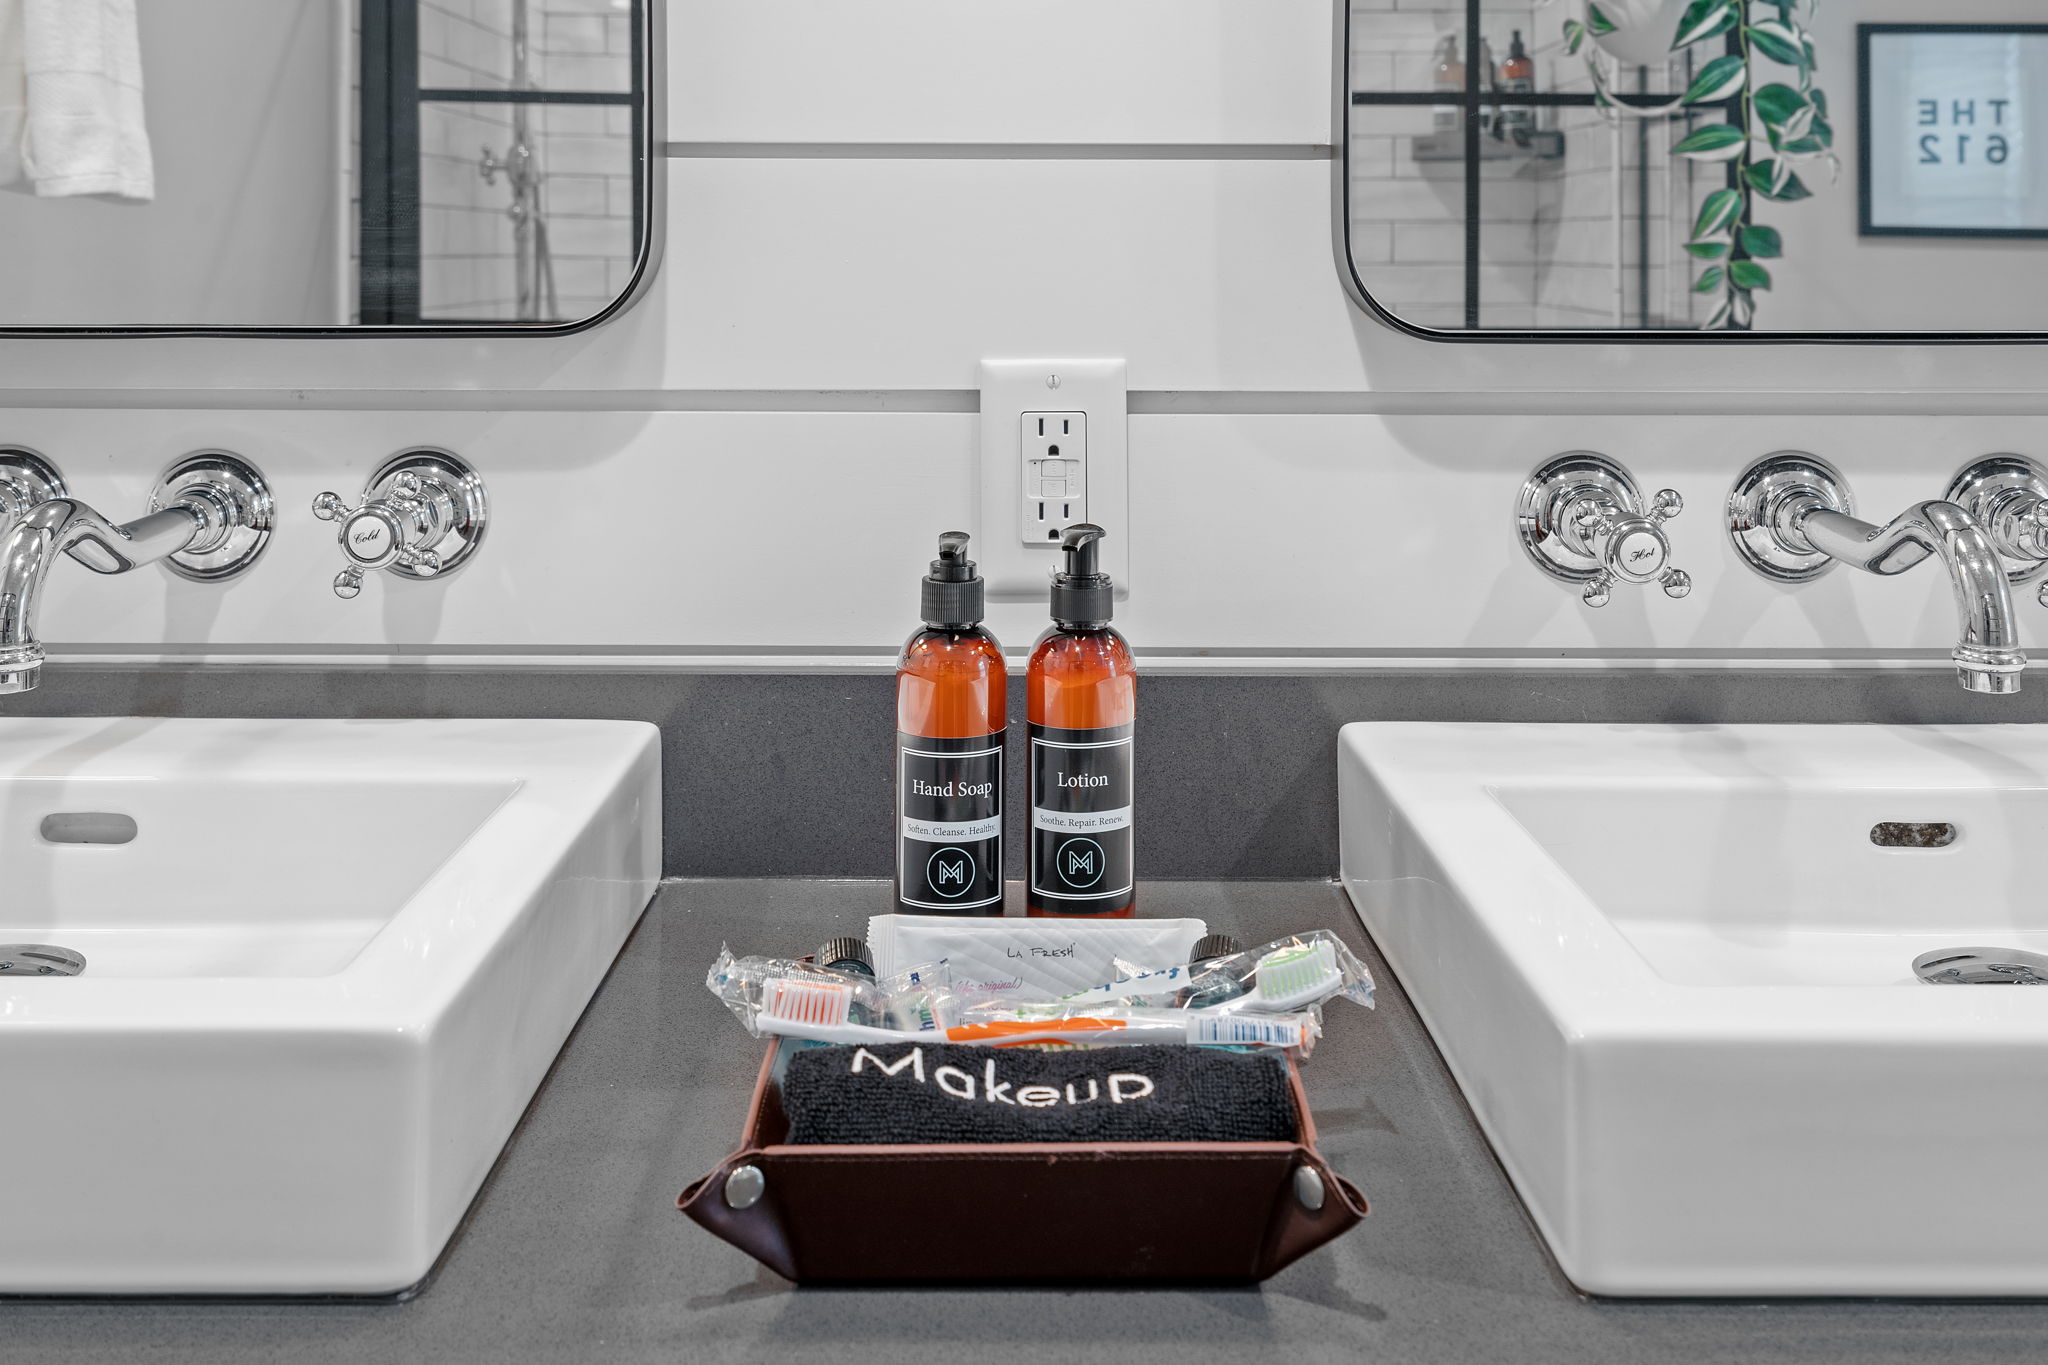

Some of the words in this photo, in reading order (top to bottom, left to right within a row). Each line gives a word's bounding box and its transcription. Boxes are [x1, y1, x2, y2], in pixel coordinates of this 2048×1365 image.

[353, 528, 381, 544] Cold
[1629, 547, 1655, 563] Hot
[1057, 772, 1109, 788] Lotion
[912, 779, 953, 797] Hand
[957, 781, 992, 799] Soap
[907, 823, 931, 836] Soften.
[932, 827, 967, 837] Cleanse.
[1039, 815, 1066, 826] Soothe.
[1068, 818, 1097, 829] Repair.
[850, 1046, 1155, 1107] Makeup
